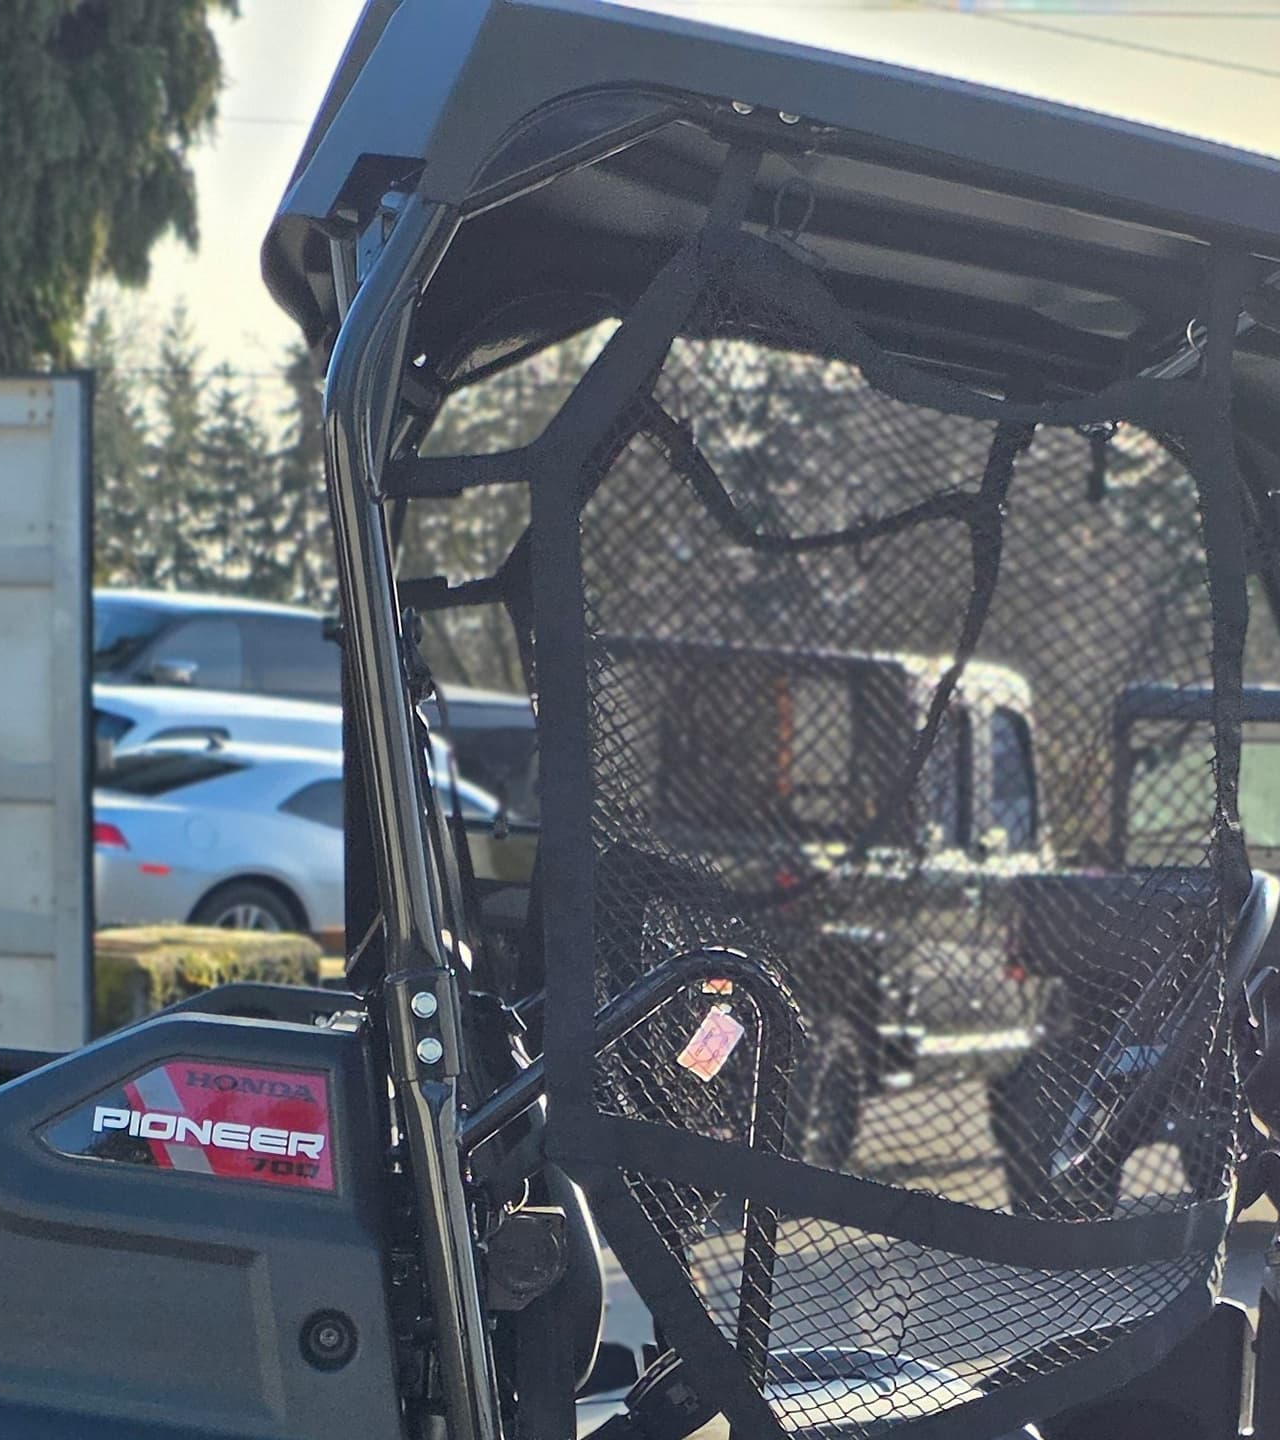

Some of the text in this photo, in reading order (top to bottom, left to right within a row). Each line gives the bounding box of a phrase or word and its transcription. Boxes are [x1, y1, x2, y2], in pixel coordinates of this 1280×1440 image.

[186, 1069, 316, 1104] HONDA
[92, 1105, 325, 1160] PIONEER
[248, 1157, 320, 1179] 700
